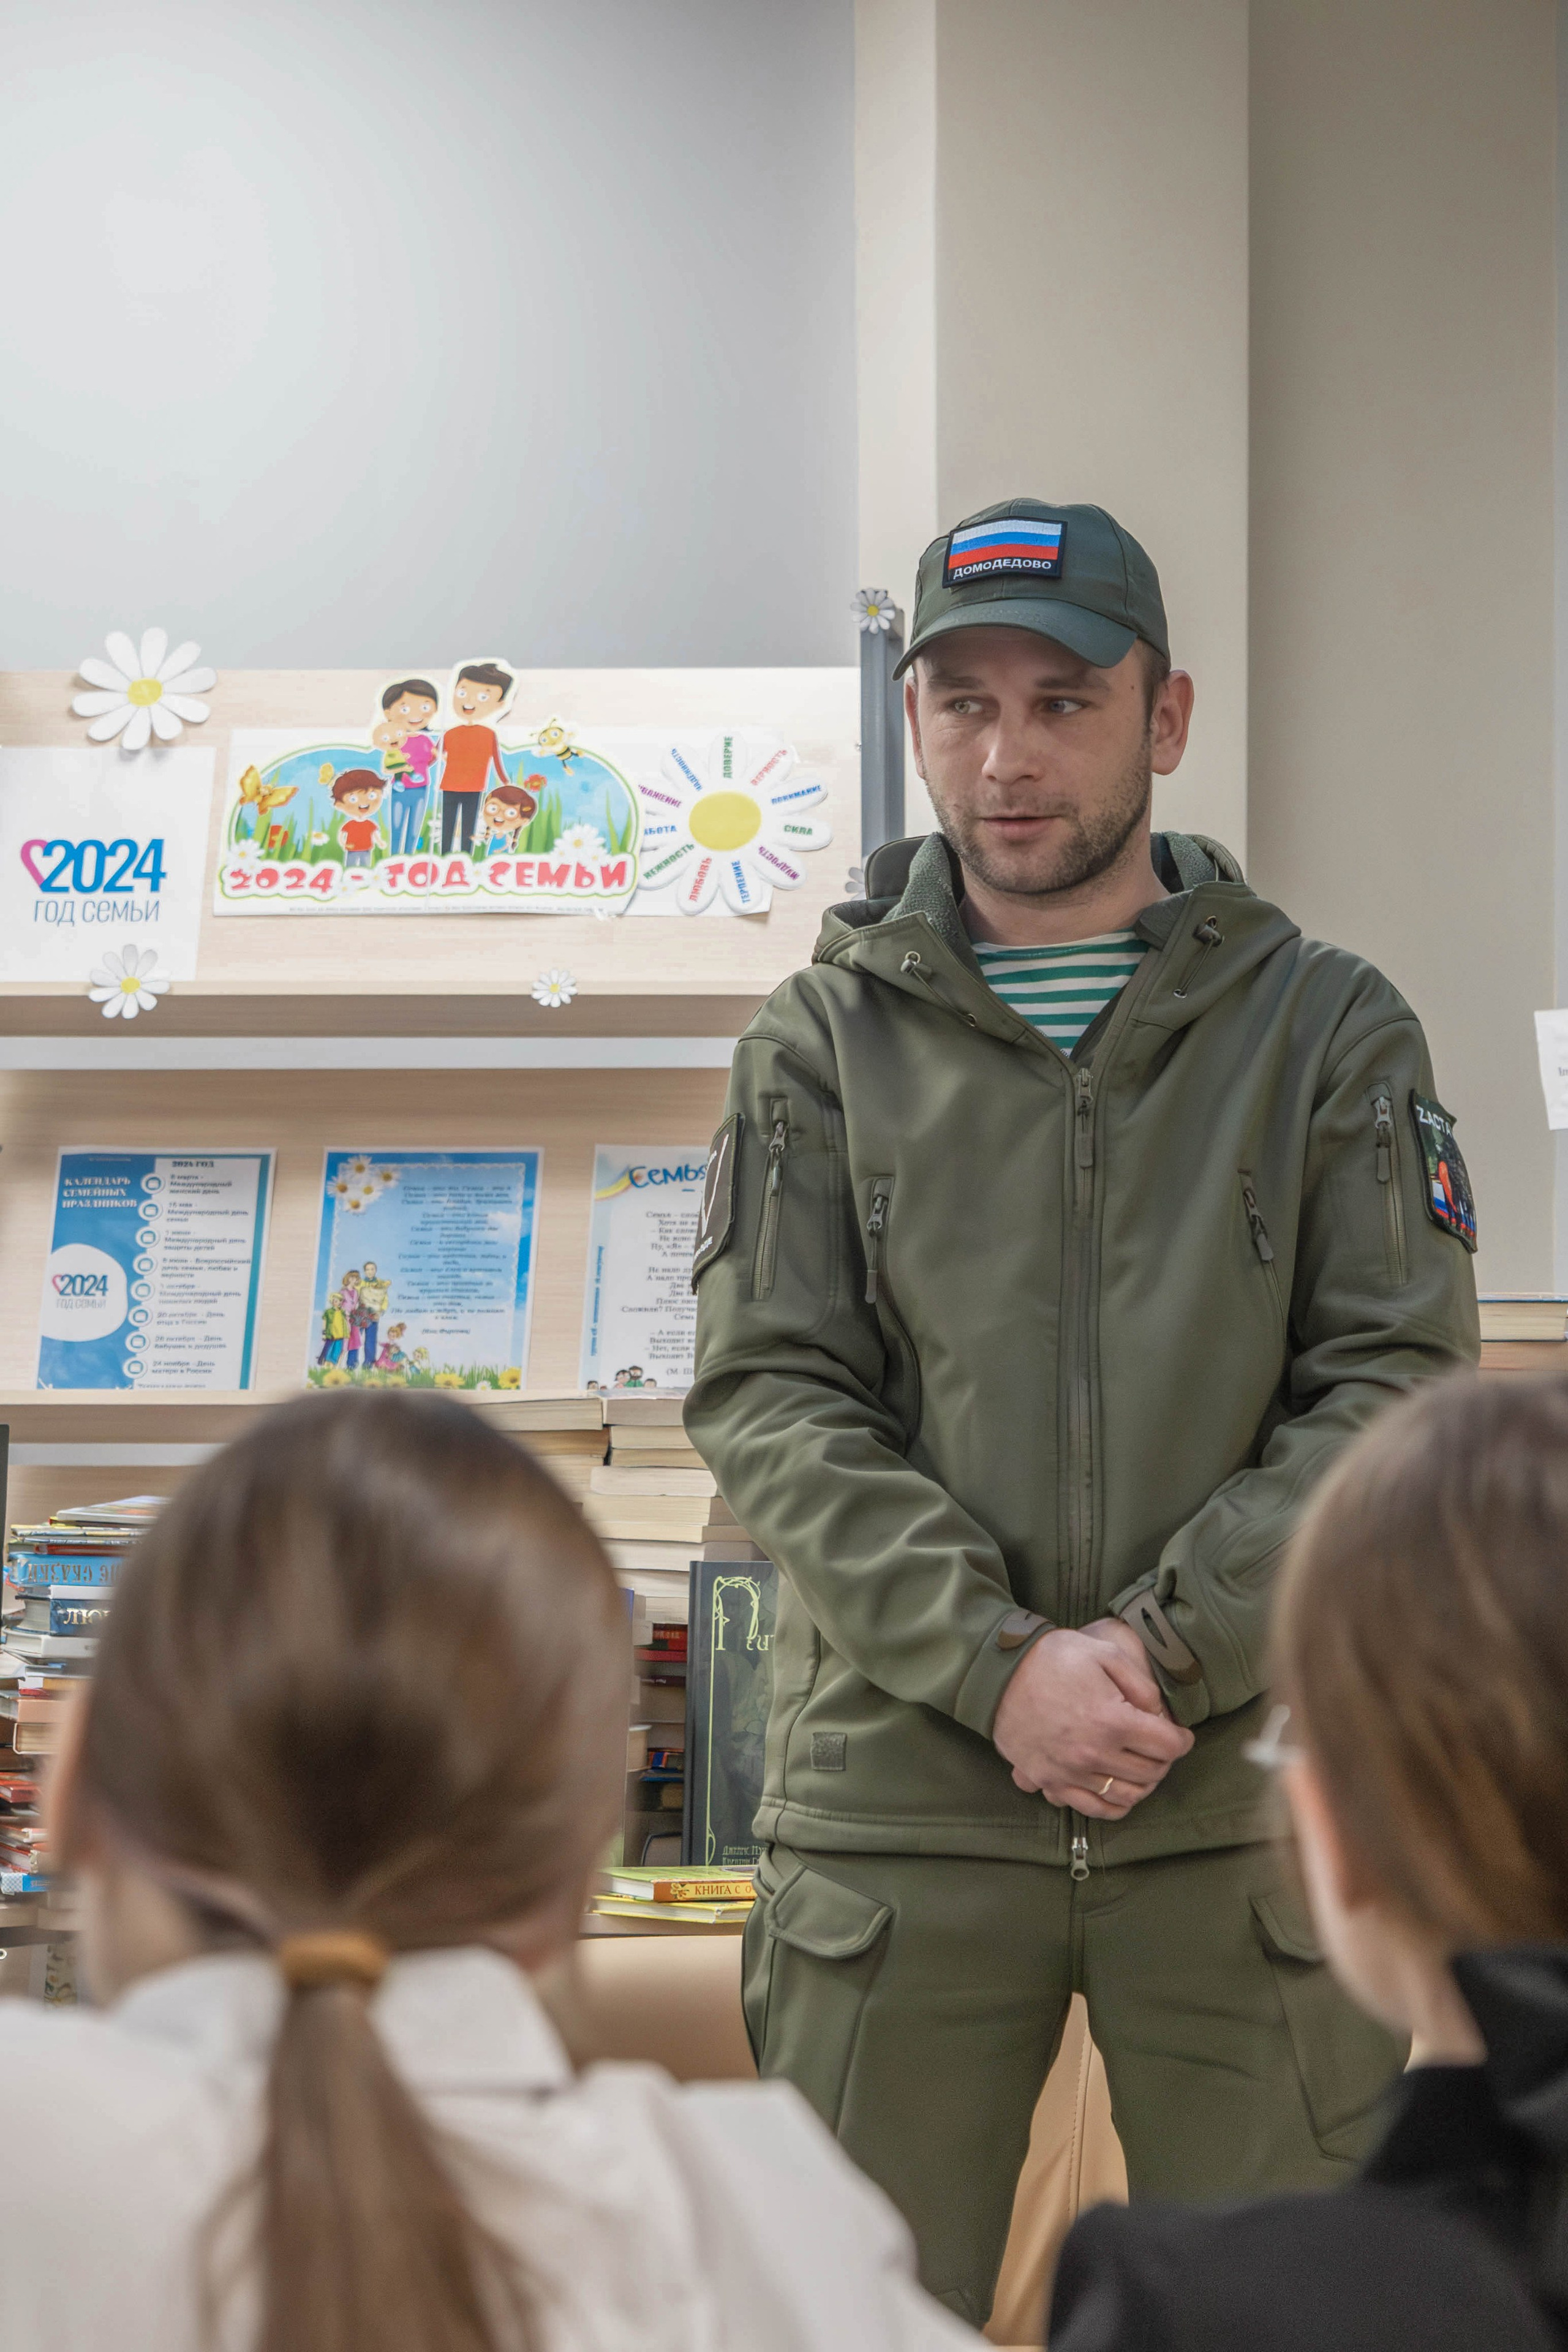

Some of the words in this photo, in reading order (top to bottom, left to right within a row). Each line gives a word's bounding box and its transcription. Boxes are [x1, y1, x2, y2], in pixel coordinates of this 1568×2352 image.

[953, 559, 1052, 579] ДОМОДЕДОВО
[723, 736, 733, 778] ДОВЕРИЕ
[638, 785, 682, 809] ВАЖЕНИЕ
[644, 825, 677, 836] АБОТА
[783, 824, 813, 836] СИЛА
[40, 839, 167, 893] 2024
[643, 843, 695, 880] НЕЖНОСТЬ
[230, 867, 334, 894] 2024
[384, 860, 469, 889] ГОД
[489, 861, 628, 889] СЕМЬИ
[689, 857, 712, 902] ЛЮБОВЬ
[731, 860, 751, 904] ТЕРПЕНИЕ
[64, 1176, 131, 1186] КАЛЕНДАРЬ
[63, 1187, 127, 1197] СЕМЕЙНЫХ
[62, 1199, 138, 1208] ПРАЗДНИКОВ
[59, 1274, 109, 1296] 2024
[28, 1564, 92, 1583] СКАЗКИ
[695, 1885, 731, 1895] КНИГА
